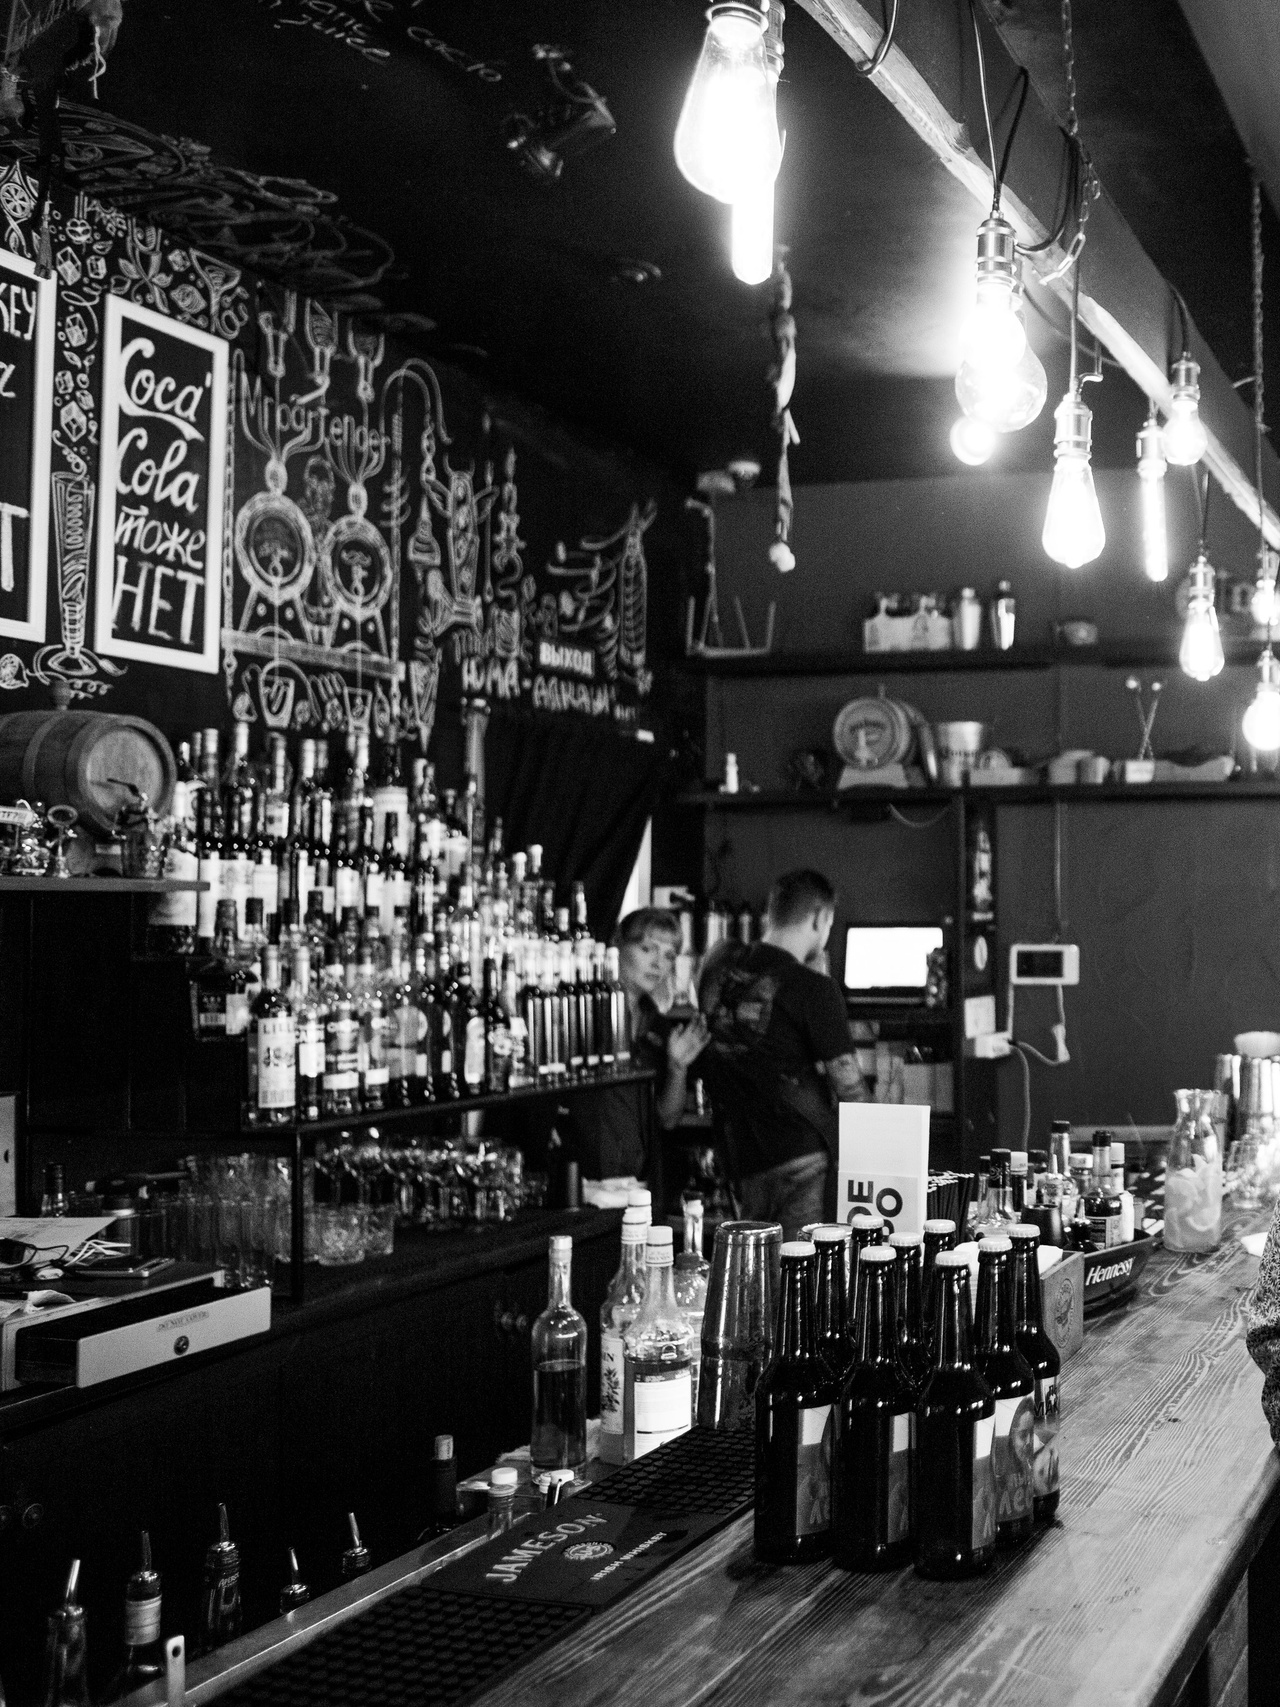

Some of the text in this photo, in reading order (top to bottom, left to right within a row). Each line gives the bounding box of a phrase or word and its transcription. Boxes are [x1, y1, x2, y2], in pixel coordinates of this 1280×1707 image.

[116, 427, 200, 513] Cola
[115, 505, 206, 569] тоже
[110, 555, 205, 645] НЕТ
[540, 641, 593, 677] ВЫХОД
[1085, 1257, 1136, 1286] Hennessy
[485, 1513, 608, 1583] JAMESON
